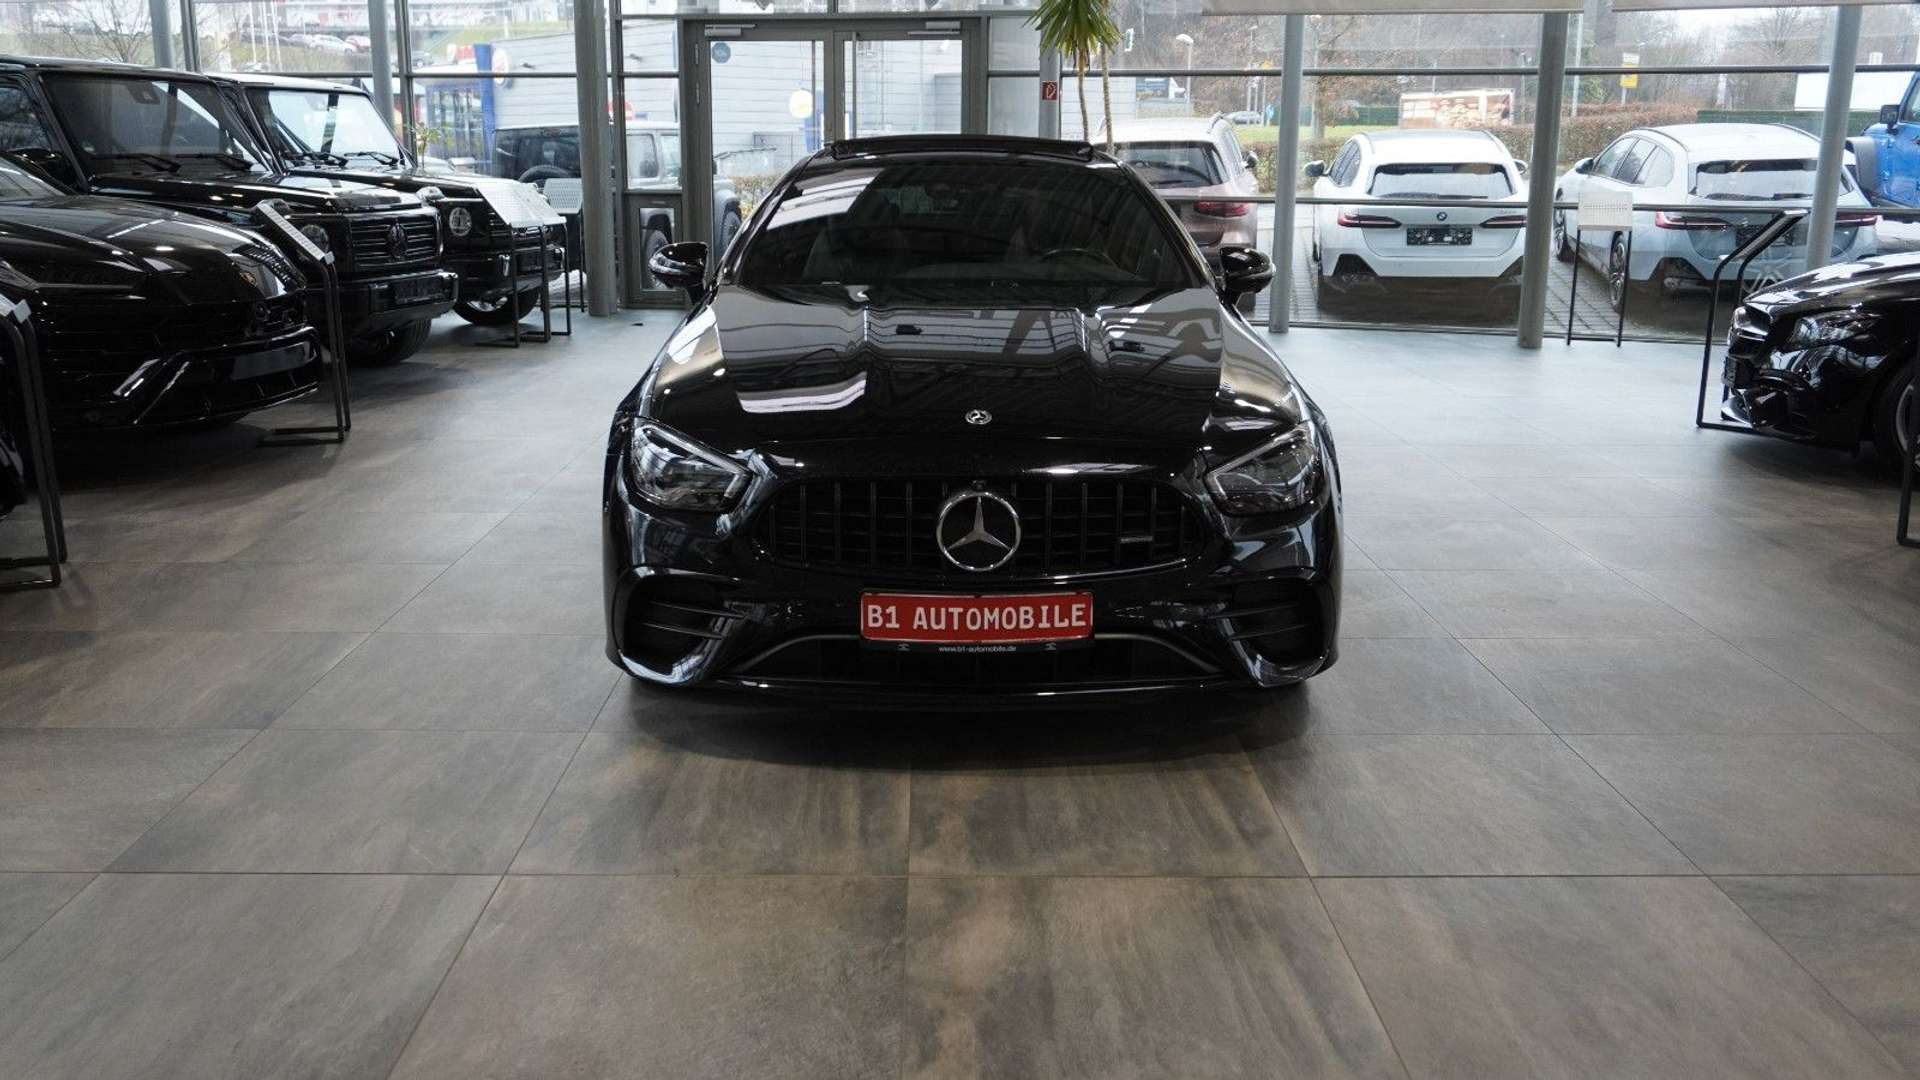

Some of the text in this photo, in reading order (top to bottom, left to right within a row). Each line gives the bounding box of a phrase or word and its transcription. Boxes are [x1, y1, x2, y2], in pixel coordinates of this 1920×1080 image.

[867, 603, 1087, 631] B1 AUTOMOBILE
[938, 645, 1017, 653] www.b1-automobile.de
